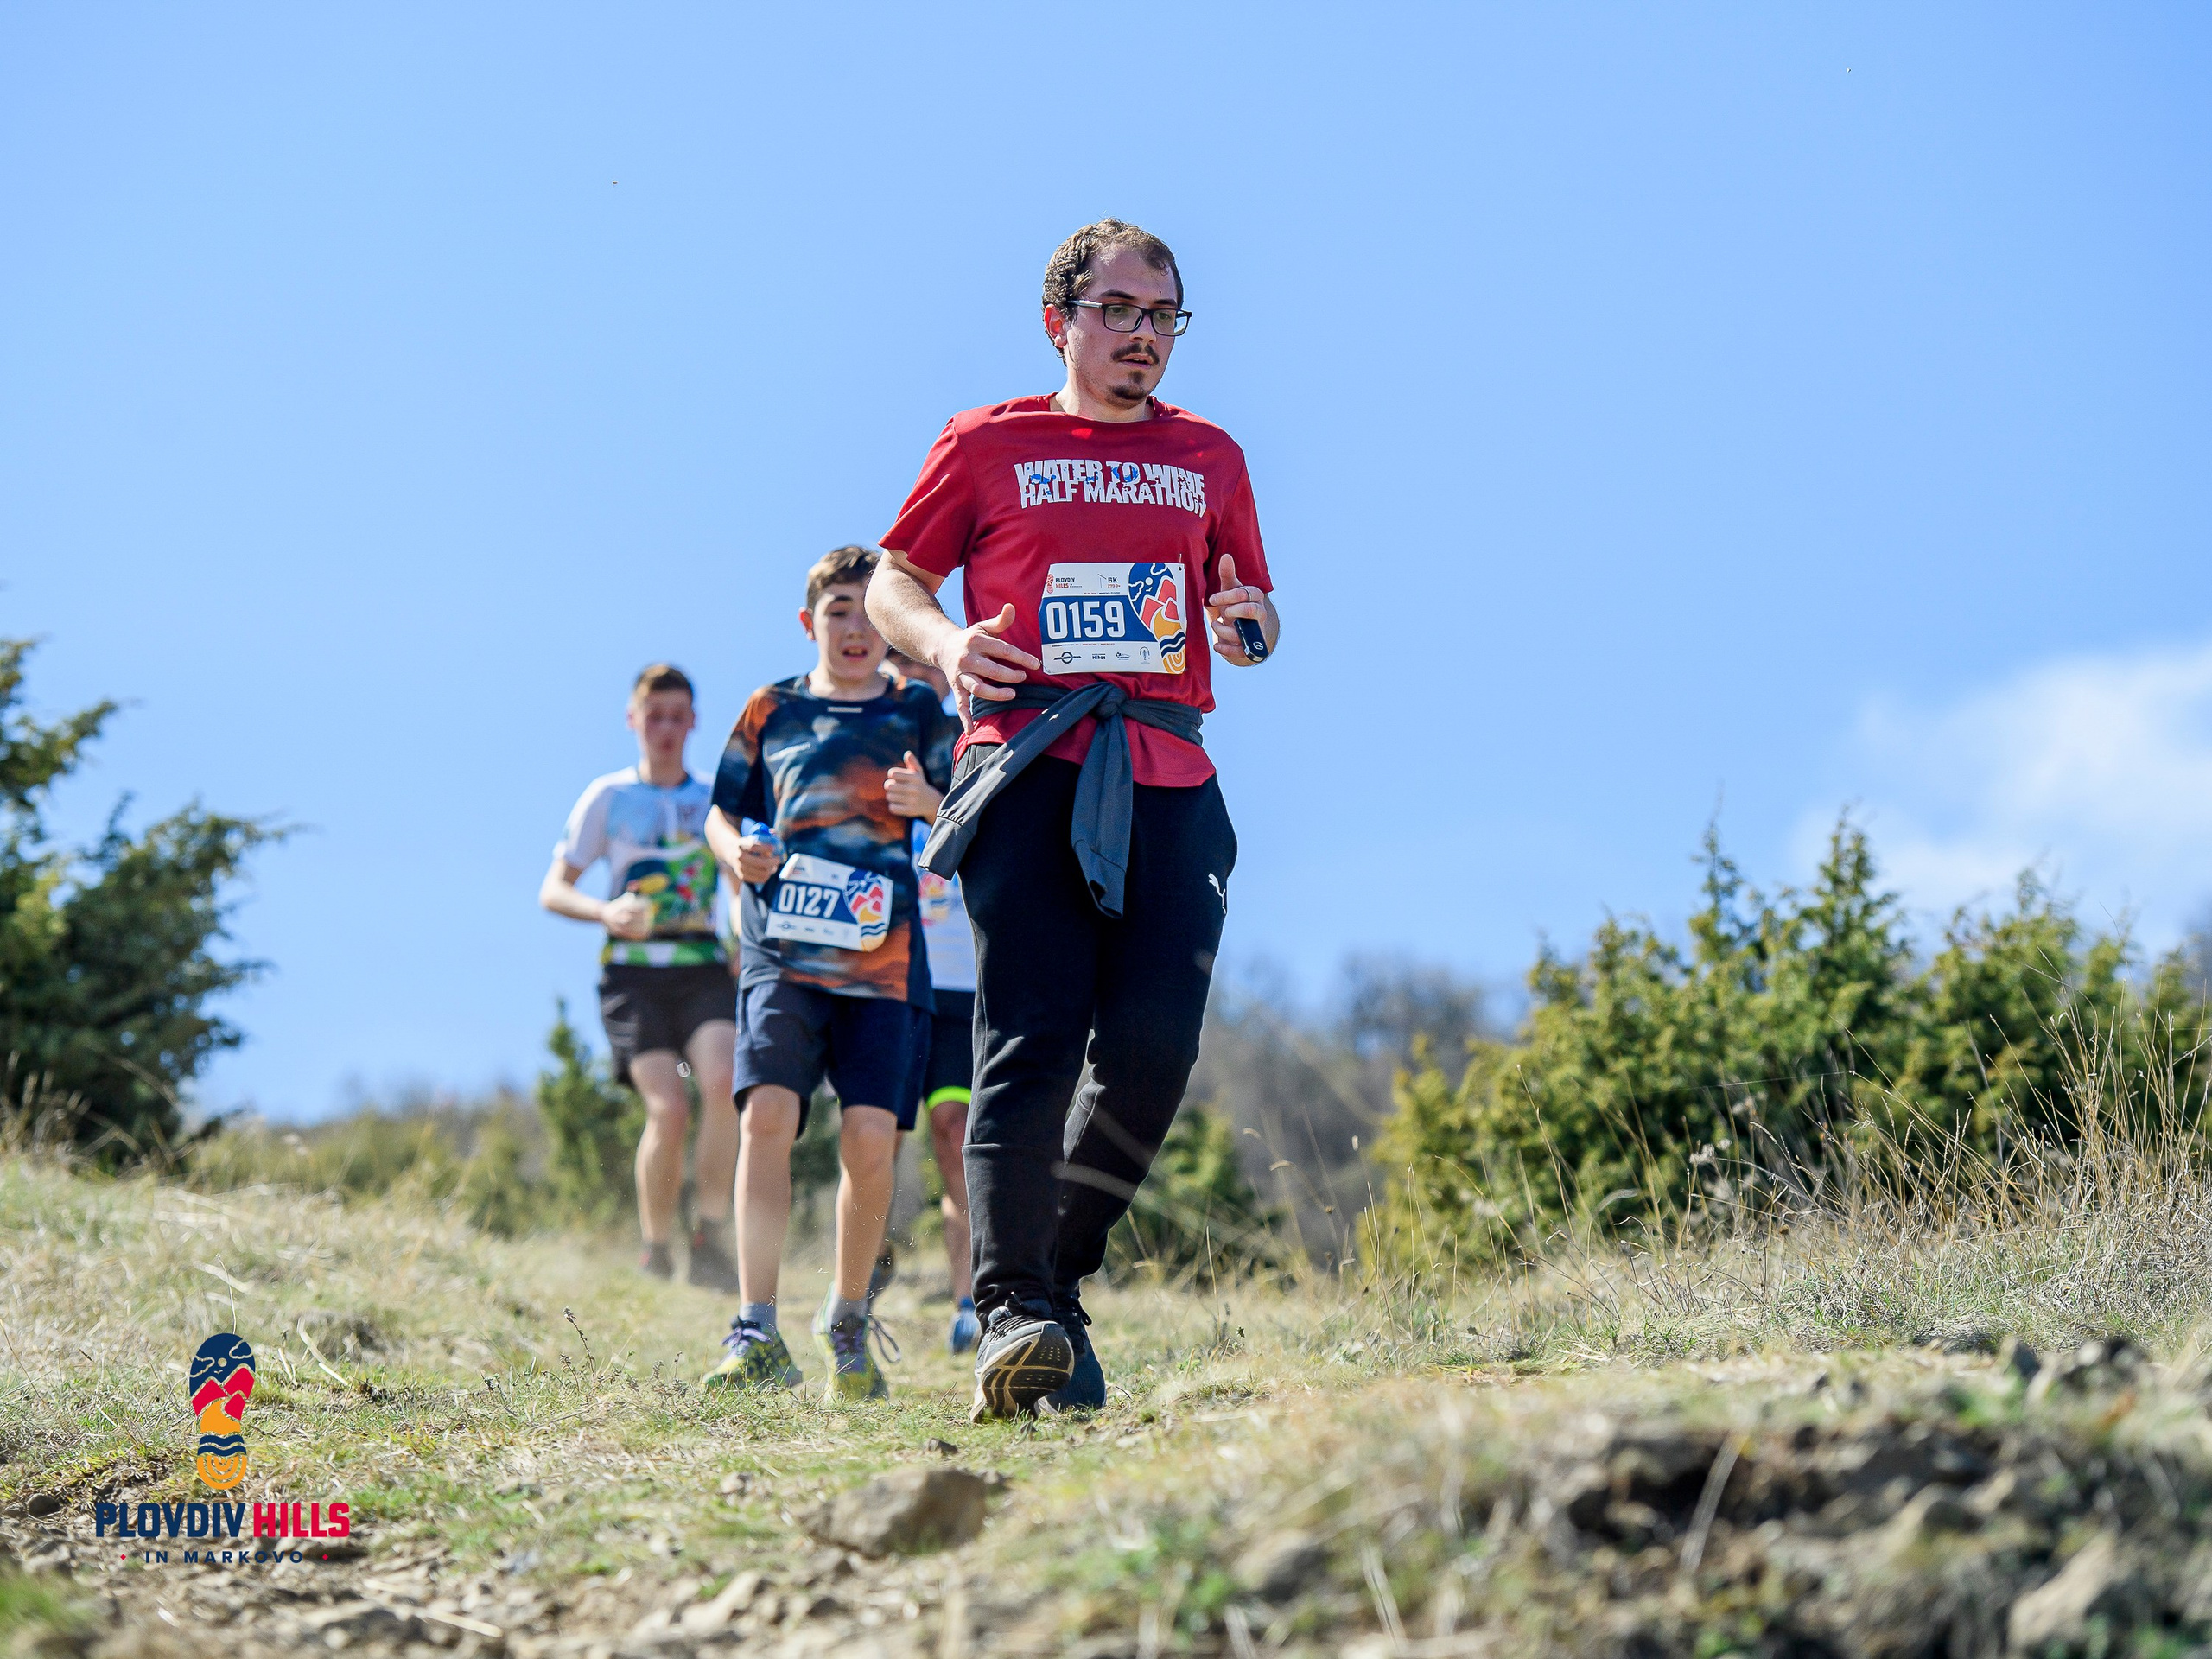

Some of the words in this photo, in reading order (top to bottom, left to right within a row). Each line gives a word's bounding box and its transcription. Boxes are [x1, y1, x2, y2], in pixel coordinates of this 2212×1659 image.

[1014, 459, 1104, 486] WATER
[1106, 461, 1141, 483] TO
[1142, 463, 1205, 498] WINE
[1020, 481, 1077, 509] HALF
[1084, 482, 1207, 518] MARATHON
[1046, 601, 1126, 639] 0159
[777, 882, 841, 918] 0127
